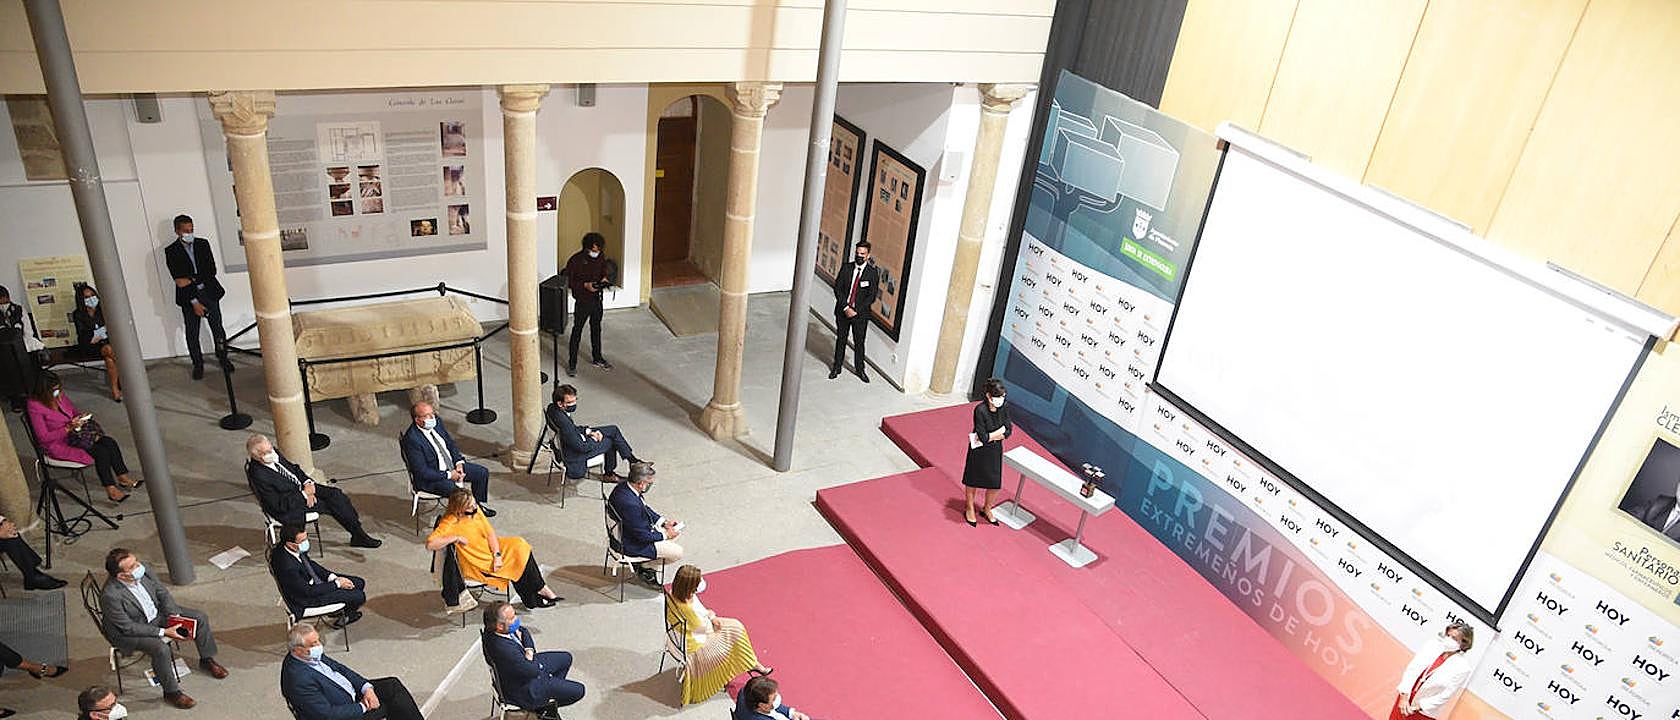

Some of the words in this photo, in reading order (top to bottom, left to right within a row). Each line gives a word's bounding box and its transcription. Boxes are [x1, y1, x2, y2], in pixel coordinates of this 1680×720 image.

[1028, 243, 1044, 256] HOY
[1021, 274, 1036, 288] HOY
[1046, 272, 1062, 287] HOY
[1072, 269, 1088, 283] HOY
[1015, 306, 1029, 319] HOY
[1039, 305, 1054, 319] HOY
[1063, 302, 1080, 316] HOY
[1091, 300, 1108, 315] HOY
[1118, 297, 1135, 312] HOY
[1031, 336, 1046, 350] HOY
[1056, 334, 1071, 348] HOY
[1081, 334, 1098, 348] HOY
[1108, 332, 1125, 346] HOY
[1138, 330, 1155, 346] HOY
[1073, 365, 1090, 380] HOY
[1099, 364, 1115, 379] HOY
[1128, 364, 1145, 380] HOY
[1119, 397, 1135, 413] HOY
[1158, 405, 1176, 421] HOY
[1176, 440, 1195, 456] HOY
[1207, 440, 1226, 456] HOY
[1226, 475, 1246, 493] HOY
[1260, 477, 1280, 496] HOY
[1280, 514, 1302, 535] HOY
[1316, 518, 1339, 538] HOY
[1142, 461, 1371, 654] PREMIOS
[1612, 541, 1679, 585] SANITARIO
[1338, 558, 1362, 578] HOY
[1378, 563, 1402, 583] HOY
[1140, 497, 1264, 606] EXTREMEÑOS
[1269, 601, 1299, 635] DE
[1303, 631, 1352, 676] HOY
[1536, 592, 1568, 616] HOY
[1402, 604, 1428, 626] HOY
[1596, 600, 1630, 626] HOY
[1514, 631, 1544, 655] HOY
[1571, 641, 1604, 666] HOY
[1632, 655, 1670, 682] HOY
[1493, 669, 1522, 692] HOY
[1548, 680, 1580, 705] HOY
[1606, 695, 1642, 720] HOY
